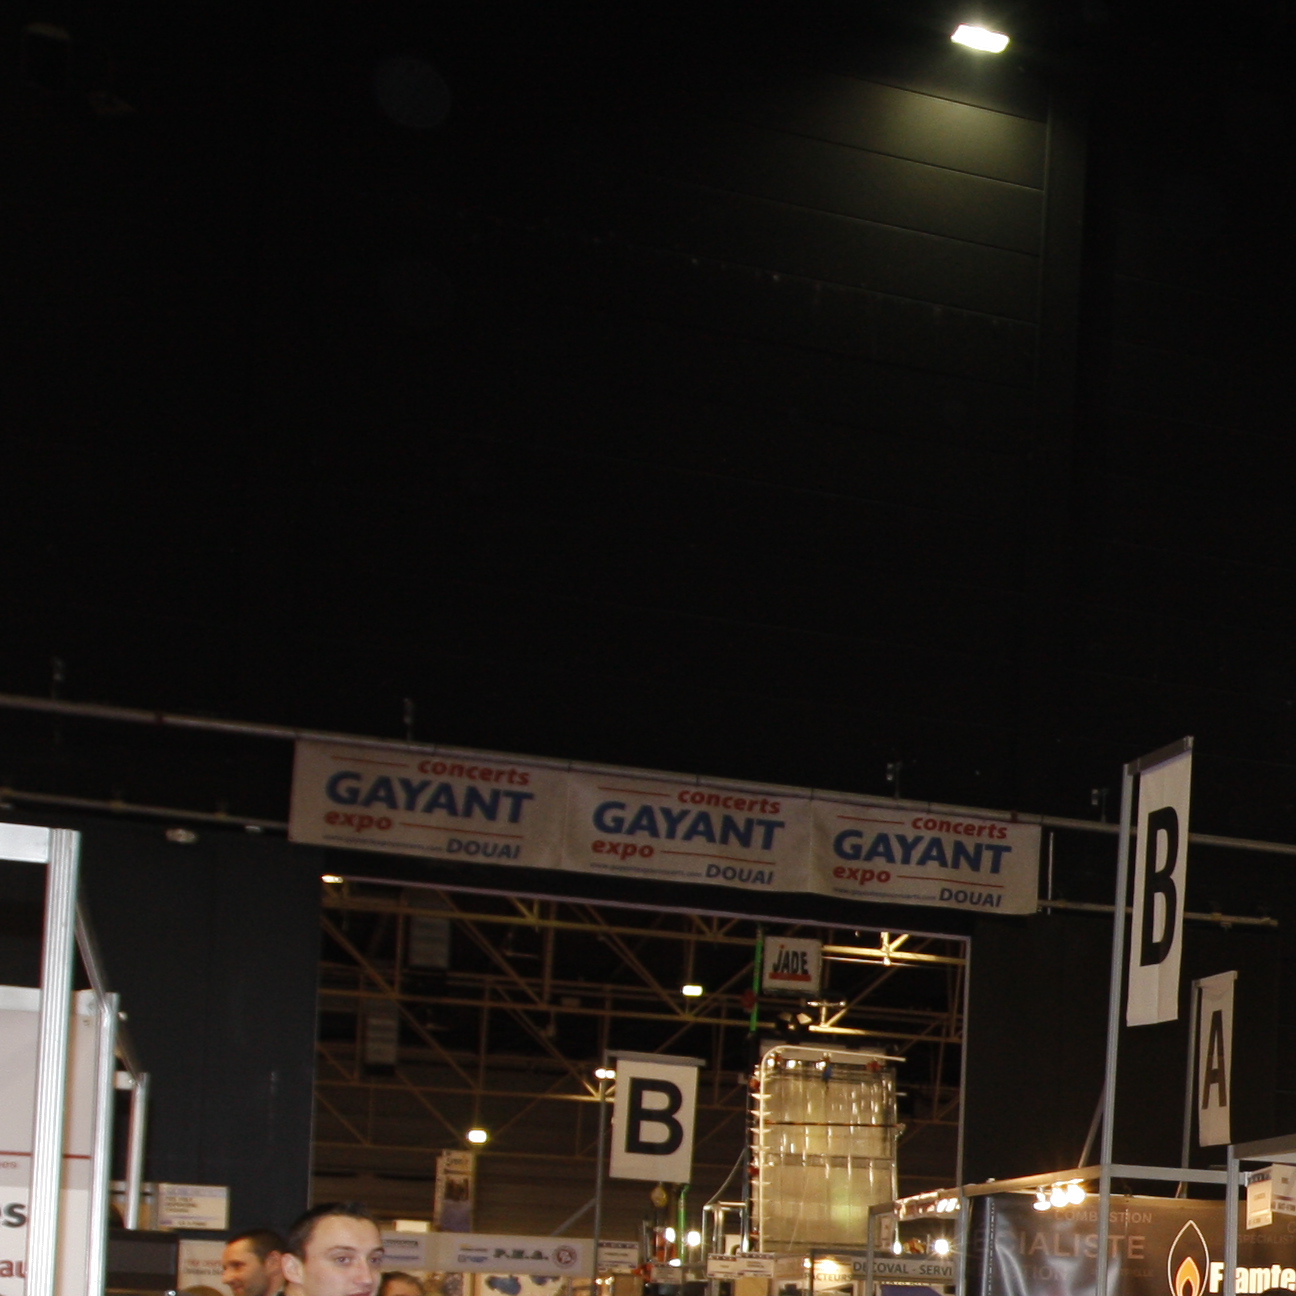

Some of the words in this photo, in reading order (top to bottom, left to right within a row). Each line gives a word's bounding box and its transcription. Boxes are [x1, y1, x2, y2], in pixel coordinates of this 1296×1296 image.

[417, 760, 530, 786] concerts
[325, 770, 534, 824] GAYANT
[677, 789, 781, 814] concerts
[324, 810, 393, 832] expo
[592, 801, 785, 850] GAYANT
[911, 816, 1008, 839] concerts
[445, 838, 521, 859] DOUAI
[591, 839, 654, 860] expo
[833, 828, 1012, 874] GAYANT
[705, 863, 774, 885] DOUAI
[832, 865, 891, 885] expo
[1140, 806, 1179, 966] B
[939, 887, 1002, 907] DOUAI
[1202, 1009, 1227, 1110] A
[624, 1077, 683, 1156] B
[1055, 1209, 1152, 1223] COMBSTION
